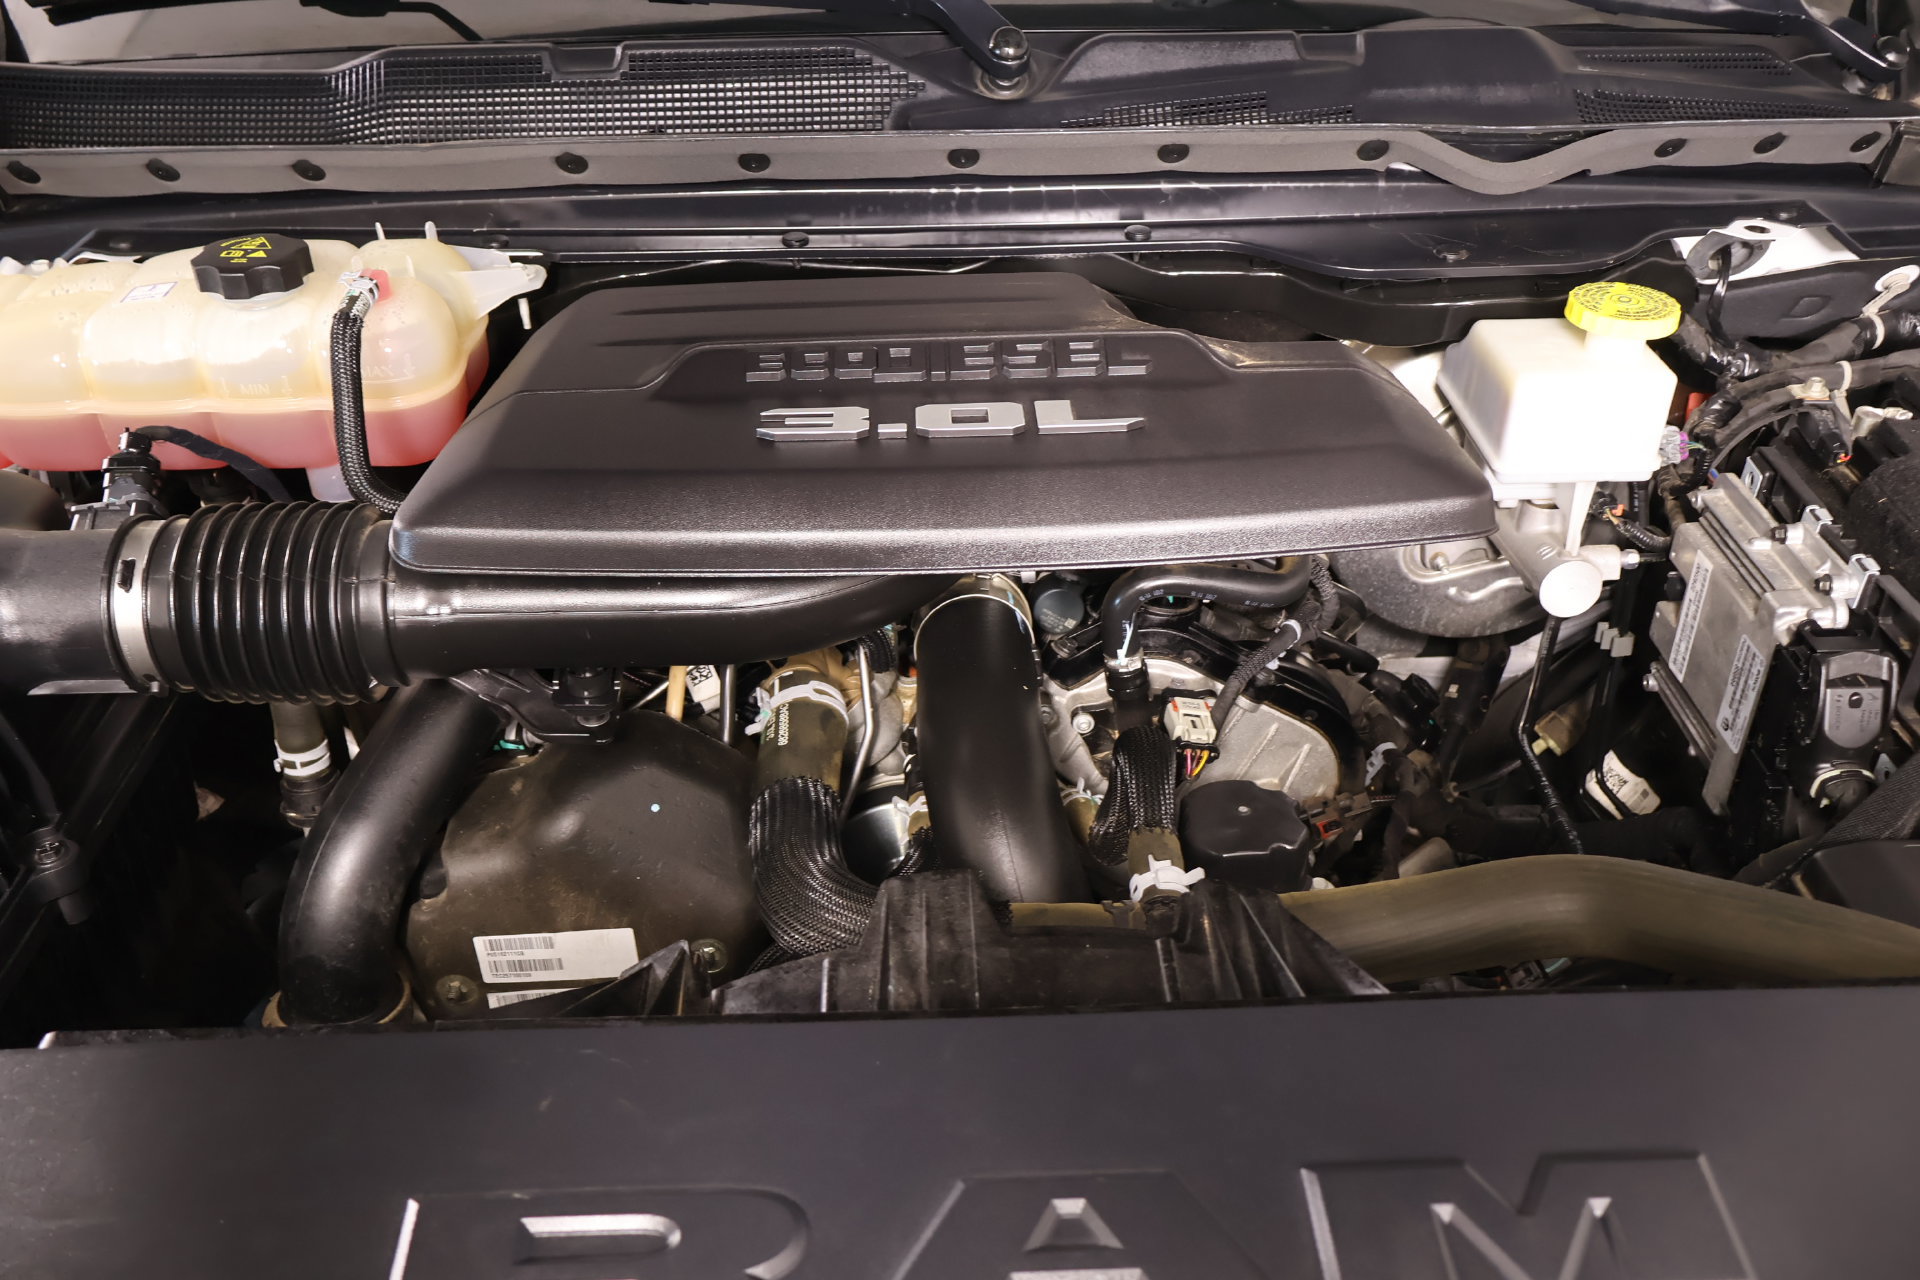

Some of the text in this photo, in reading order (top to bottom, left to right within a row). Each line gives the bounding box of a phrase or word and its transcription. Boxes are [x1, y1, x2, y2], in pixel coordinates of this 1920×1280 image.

[239, 382, 271, 396] MIN
[755, 399, 1145, 442] 3.0L
[388, 1150, 1757, 1280] RAM
